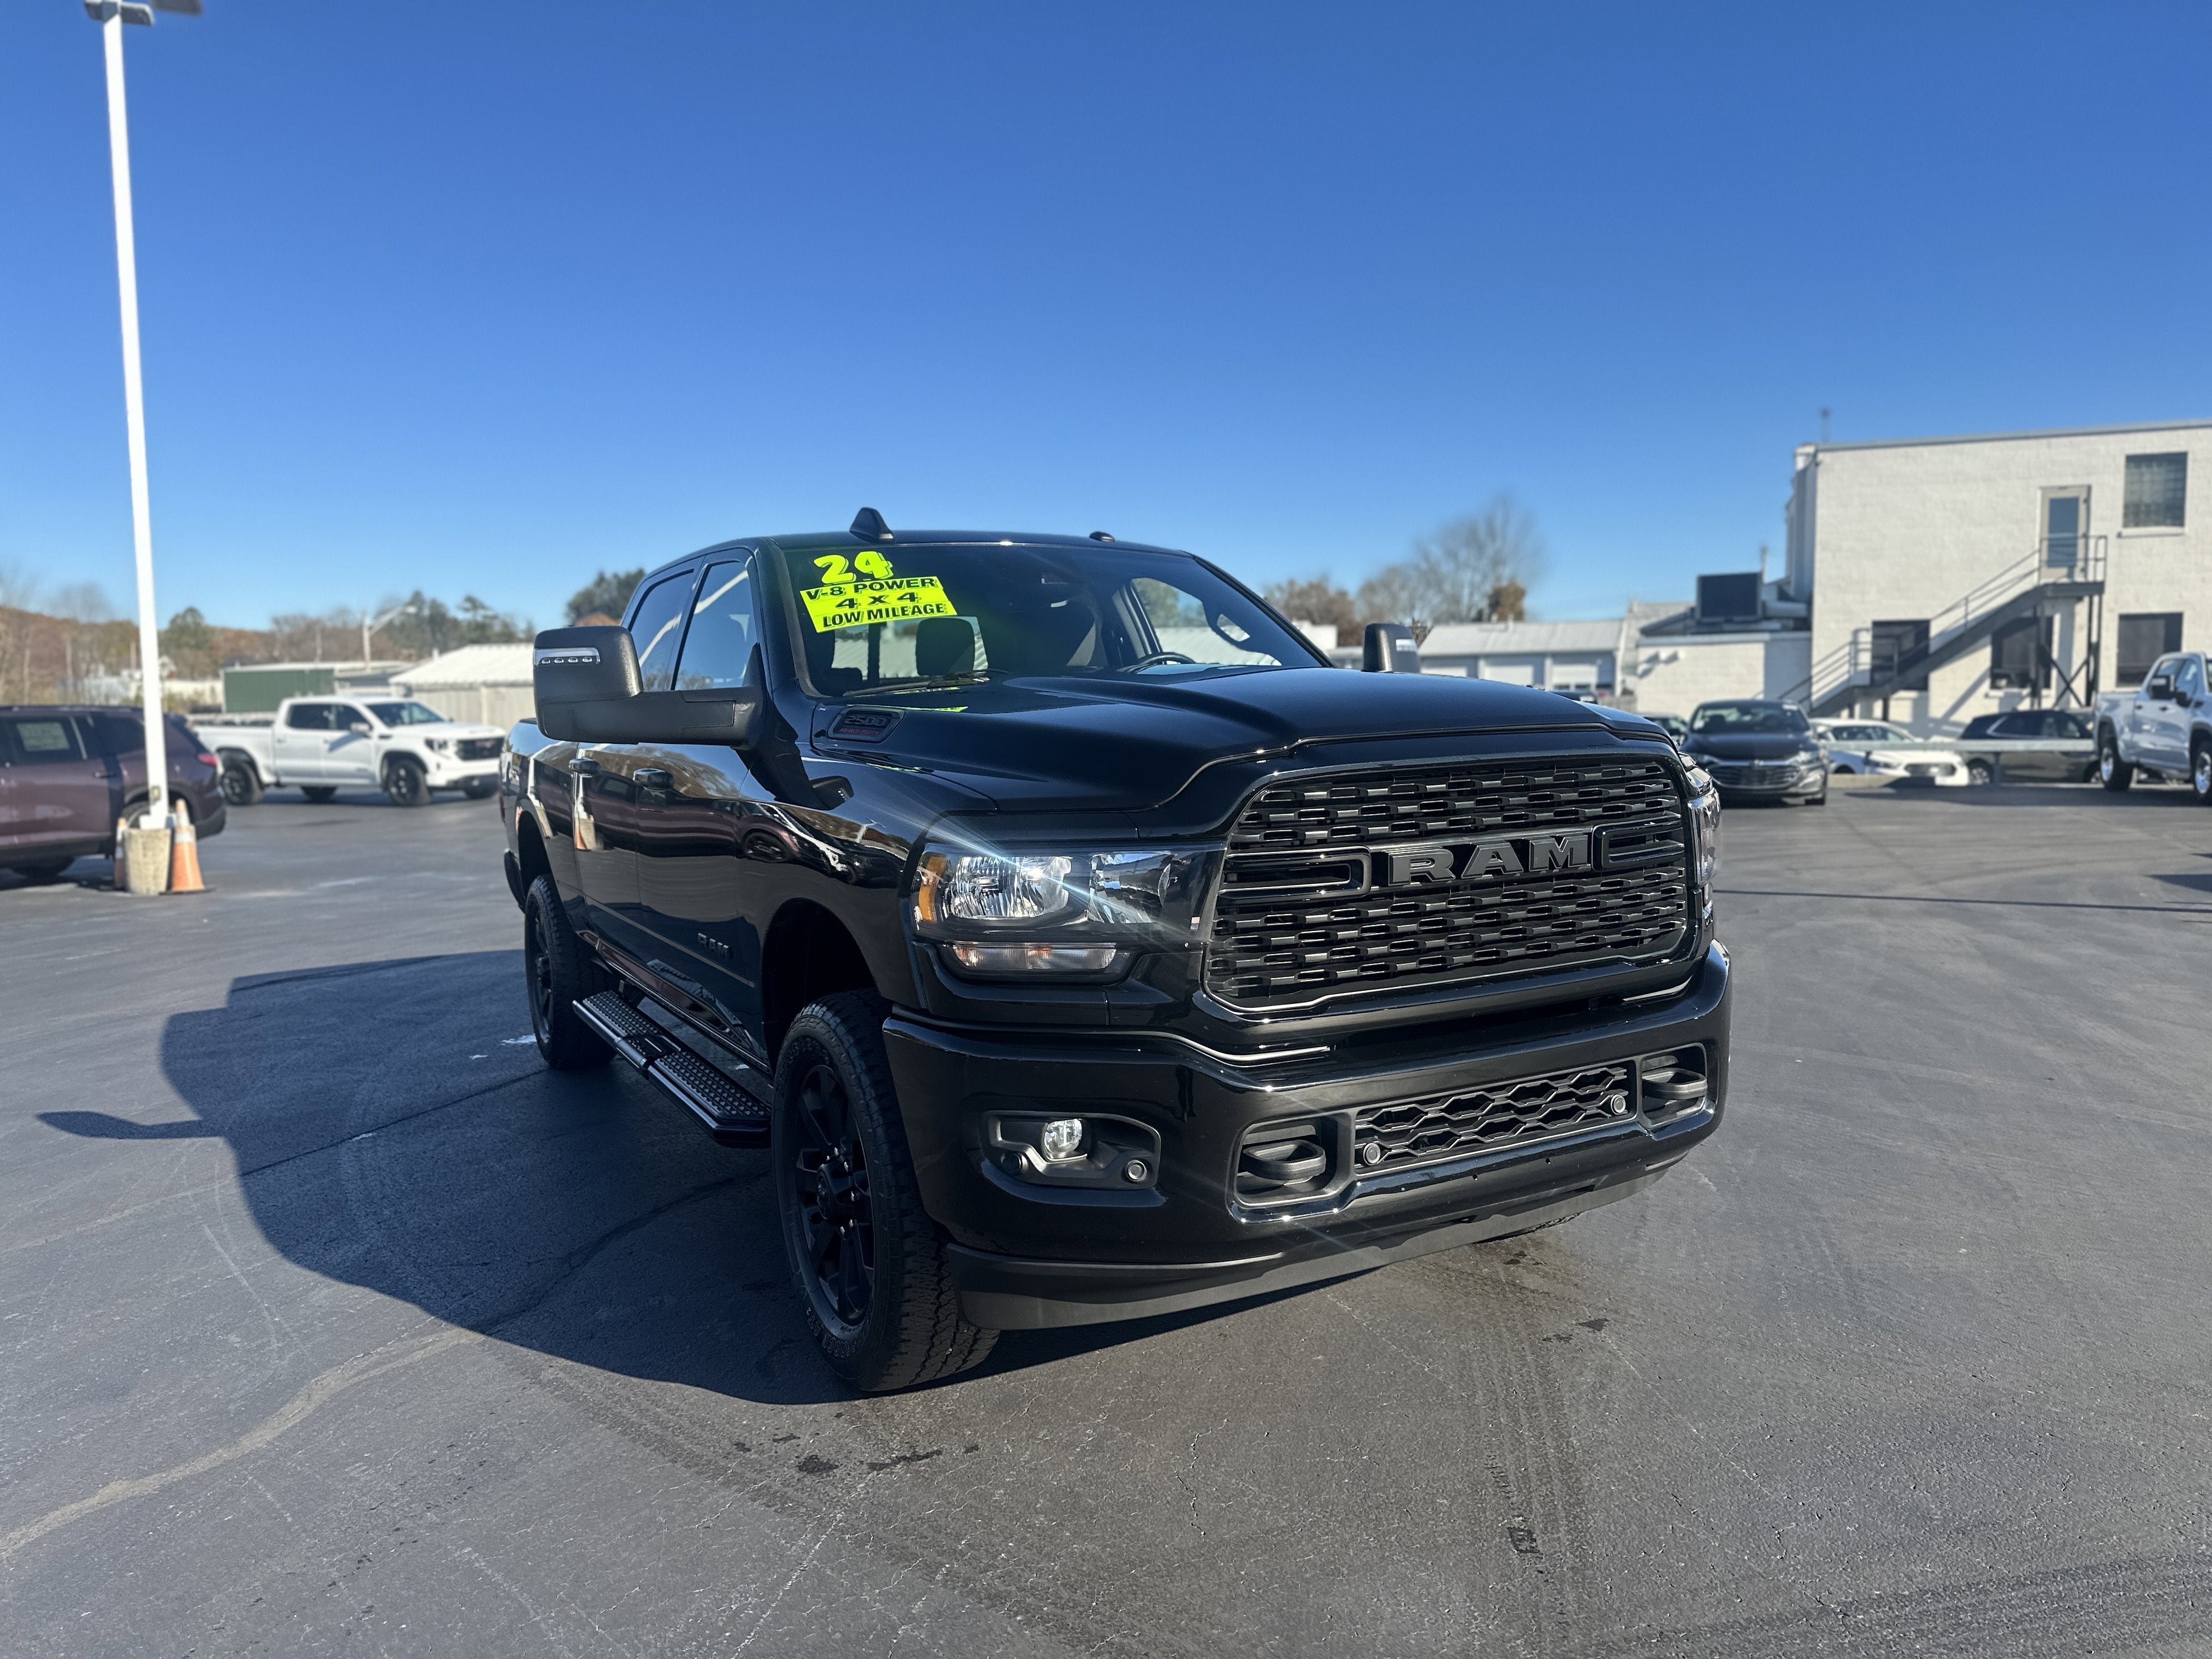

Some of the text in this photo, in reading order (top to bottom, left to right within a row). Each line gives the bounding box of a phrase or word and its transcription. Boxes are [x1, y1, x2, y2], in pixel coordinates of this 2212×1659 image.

[814, 551, 894, 585] 24
[806, 578, 937, 601] V-8 POWER
[836, 597, 859, 609] 4
[896, 591, 921, 602] 4
[823, 603, 946, 628] LOW MILEAGE
[845, 715, 889, 726] 2500
[1384, 832, 1589, 885] RAM
[698, 932, 730, 957] RAM
